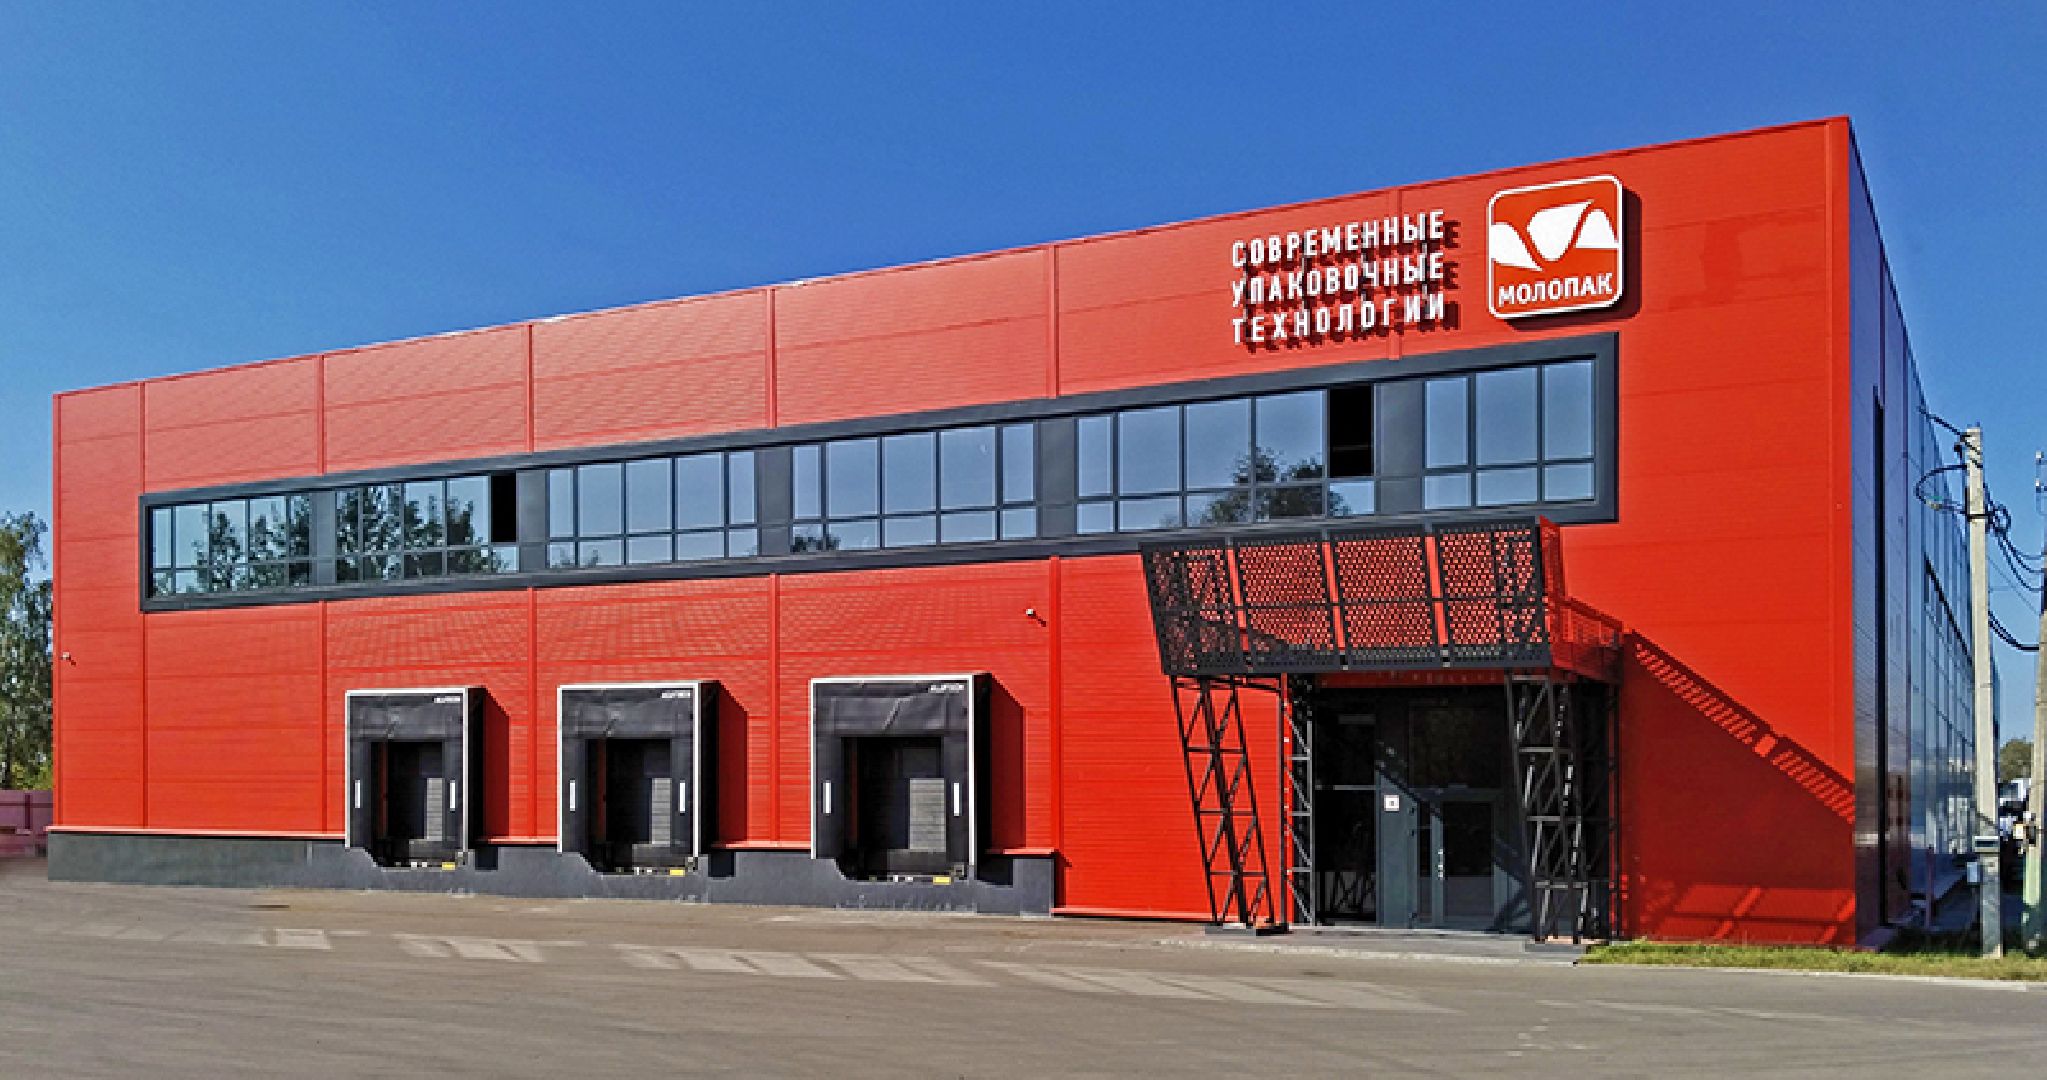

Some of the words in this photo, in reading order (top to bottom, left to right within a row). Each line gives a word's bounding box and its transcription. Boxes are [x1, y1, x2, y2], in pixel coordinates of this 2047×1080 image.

[1232, 209, 1444, 267] СОВРЕМЕННЫЕ
[1232, 252, 1444, 308] УПАКОВОЧНЫЕ
[1498, 272, 1612, 307] МОЛОПАК
[1232, 293, 1444, 345] ТЕХНОЛОГИИ
